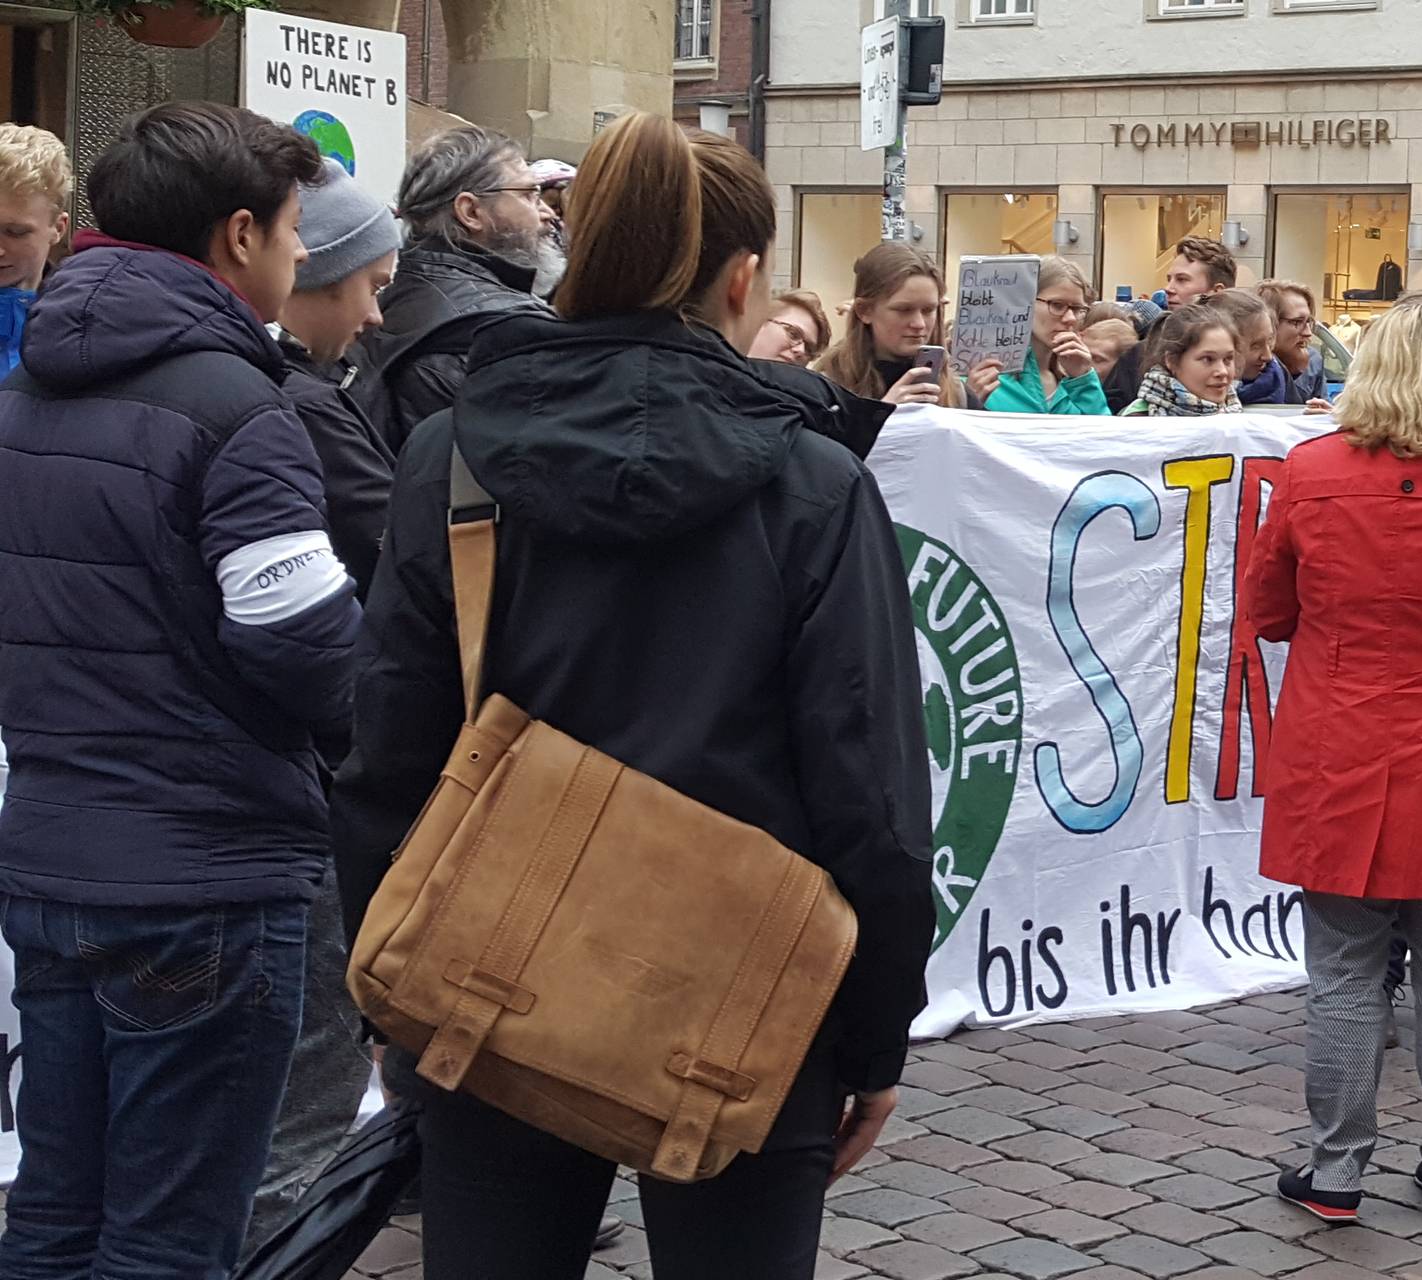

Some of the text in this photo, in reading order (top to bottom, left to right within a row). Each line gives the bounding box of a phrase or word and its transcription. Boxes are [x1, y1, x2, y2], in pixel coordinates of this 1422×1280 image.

[279, 24, 372, 63] THERE IS
[266, 60, 398, 106] NO PLANET B
[1109, 118, 1391, 151] TOMMY HILFIGER
[1012, 305, 1031, 323] und
[995, 325, 1025, 348] bleibt
[907, 541, 1020, 780] FUTURE
[977, 907, 1069, 1018] bis
[1099, 884, 1182, 997] ihr
